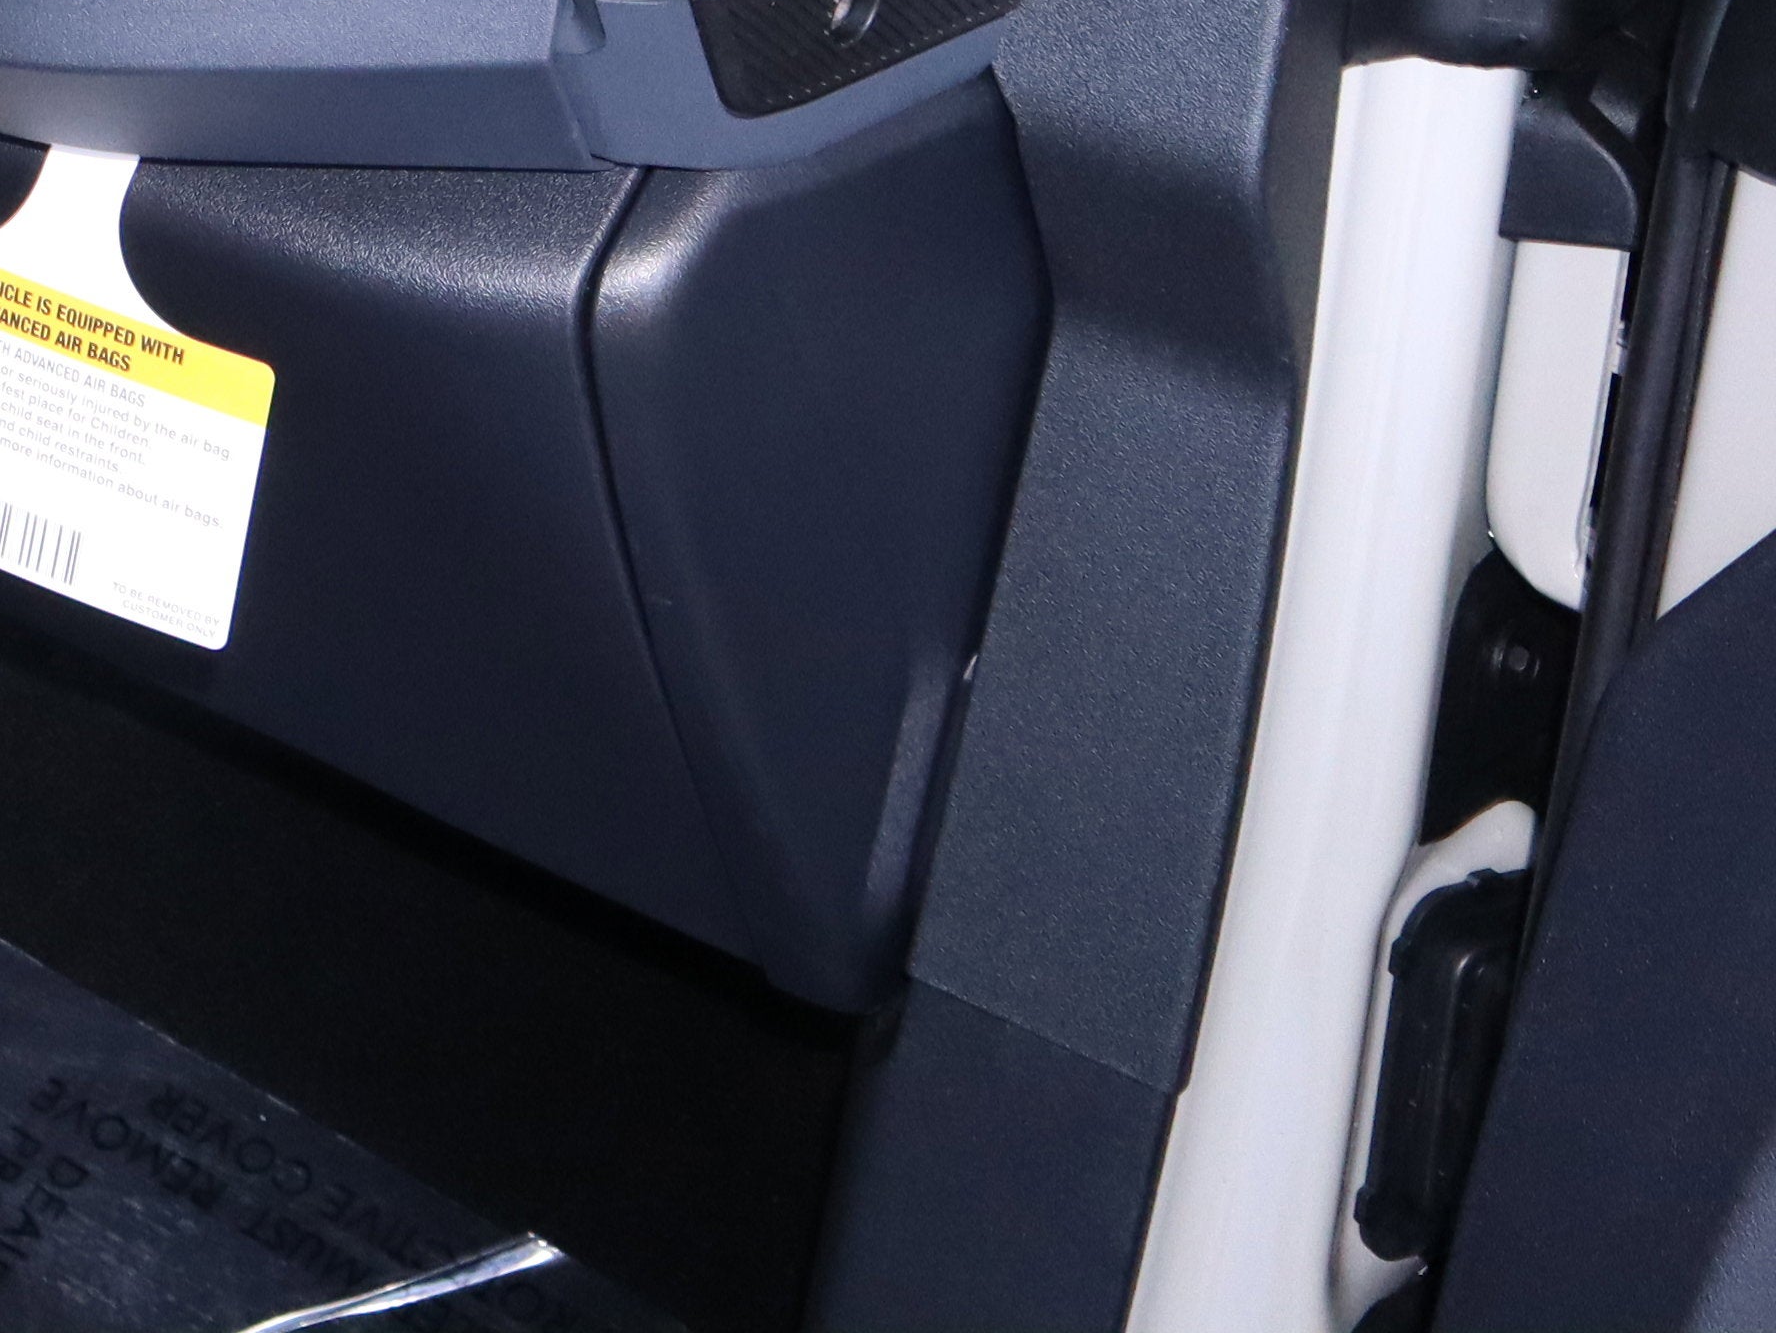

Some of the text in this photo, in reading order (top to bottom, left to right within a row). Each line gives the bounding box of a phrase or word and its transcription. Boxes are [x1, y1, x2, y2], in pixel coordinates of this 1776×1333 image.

[35, 293, 53, 318] IS
[55, 301, 137, 350] EQUIPPED
[138, 332, 186, 368] WITH
[53, 326, 83, 355] AIR
[85, 339, 132, 374] BAGS
[0, 362, 15, 379] or
[16, 367, 78, 406] seriously
[81, 392, 130, 426] injured
[132, 412, 151, 433] by
[153, 420, 178, 442] the
[179, 430, 201, 450] air
[13, 344, 81, 385] ADVANCED
[82, 371, 107, 395] AIR
[109, 381, 146, 409] BAGS
[26, 389, 65, 420] place
[67, 405, 87, 425] for
[0, 396, 34, 422] child
[35, 410, 65, 435] seat
[66, 423, 81, 440] in
[83, 429, 106, 450] the
[108, 438, 147, 466] front.
[17, 421, 51, 448] child
[35, 445, 114, 491] information
[117, 477, 158, 507] about
[160, 494, 180, 515] air
[182, 502, 224, 532] bags.
[121, 594, 183, 631] CUSTOMER
[128, 587, 144, 601] BE
[146, 591, 201, 624] REMOVED
[141, 1078, 320, 1203] COVER
[25, 1072, 365, 1293] MUST REMOVE
